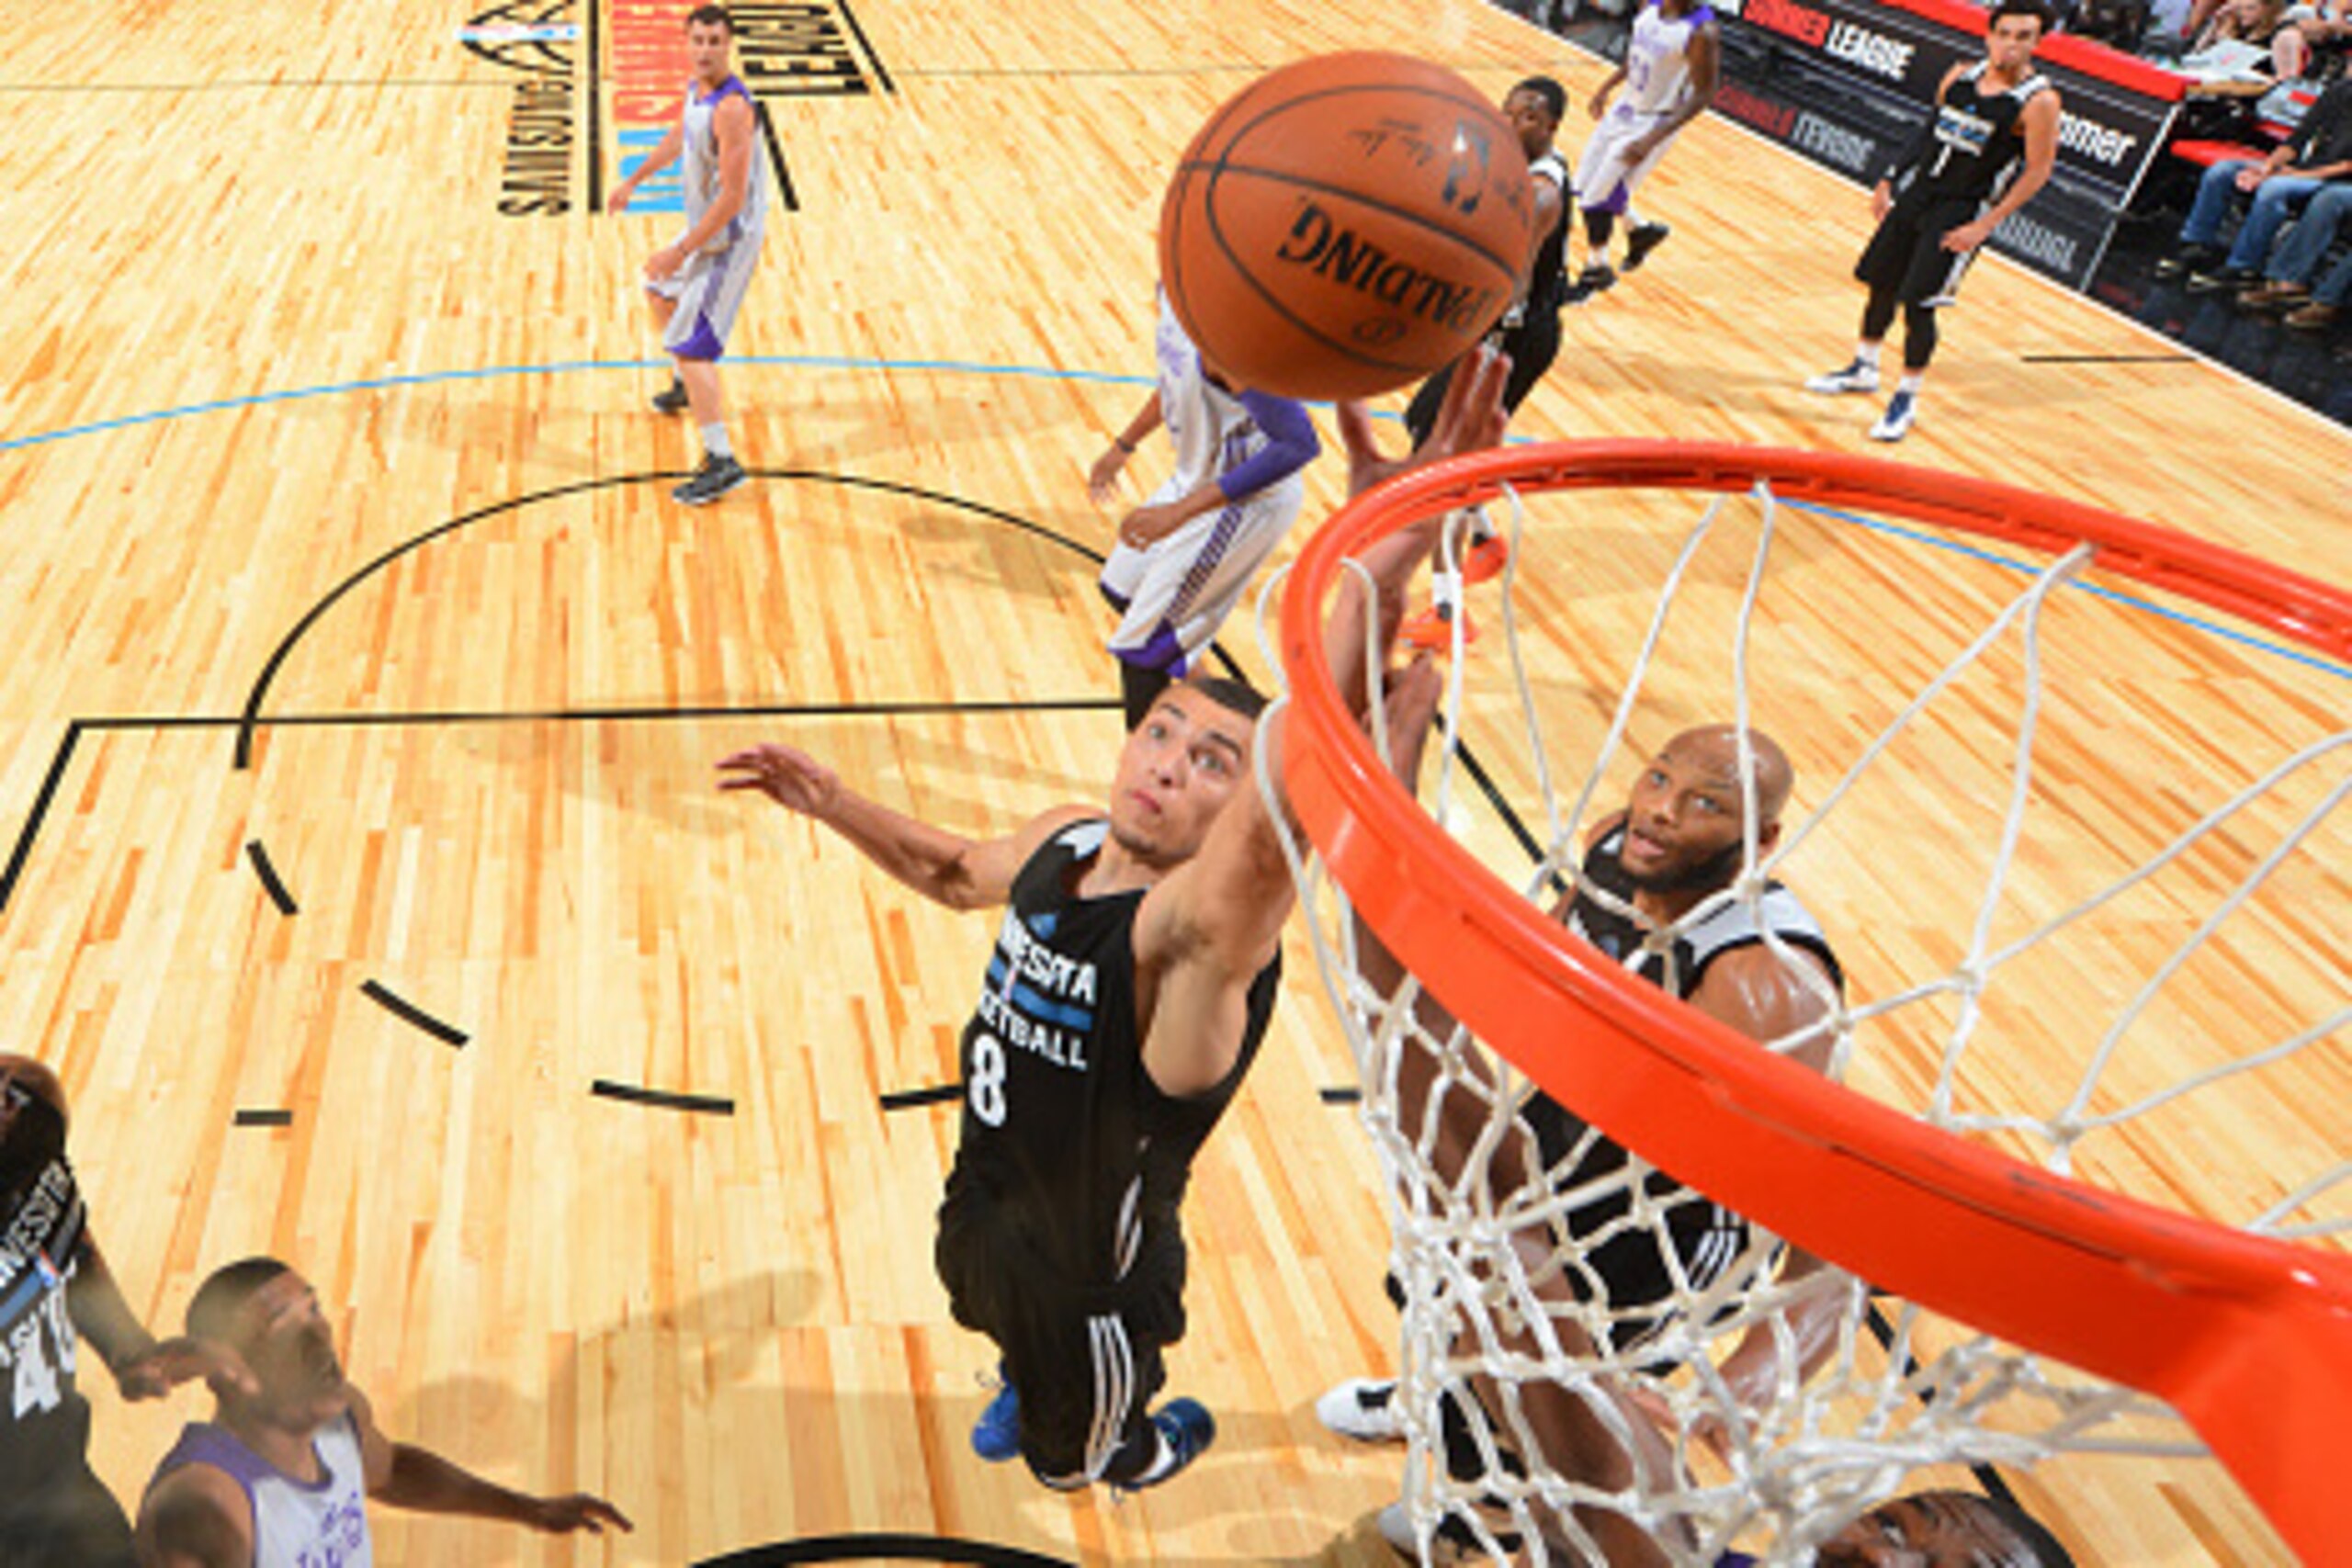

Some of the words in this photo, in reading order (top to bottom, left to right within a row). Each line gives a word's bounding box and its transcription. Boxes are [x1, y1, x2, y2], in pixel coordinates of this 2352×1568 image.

[1824, 18, 1917, 82] LEAGUE
[498, 80, 573, 216] SAMSUNG
[1276, 203, 1495, 336] PALDING
[969, 1033, 1006, 1127] 8
